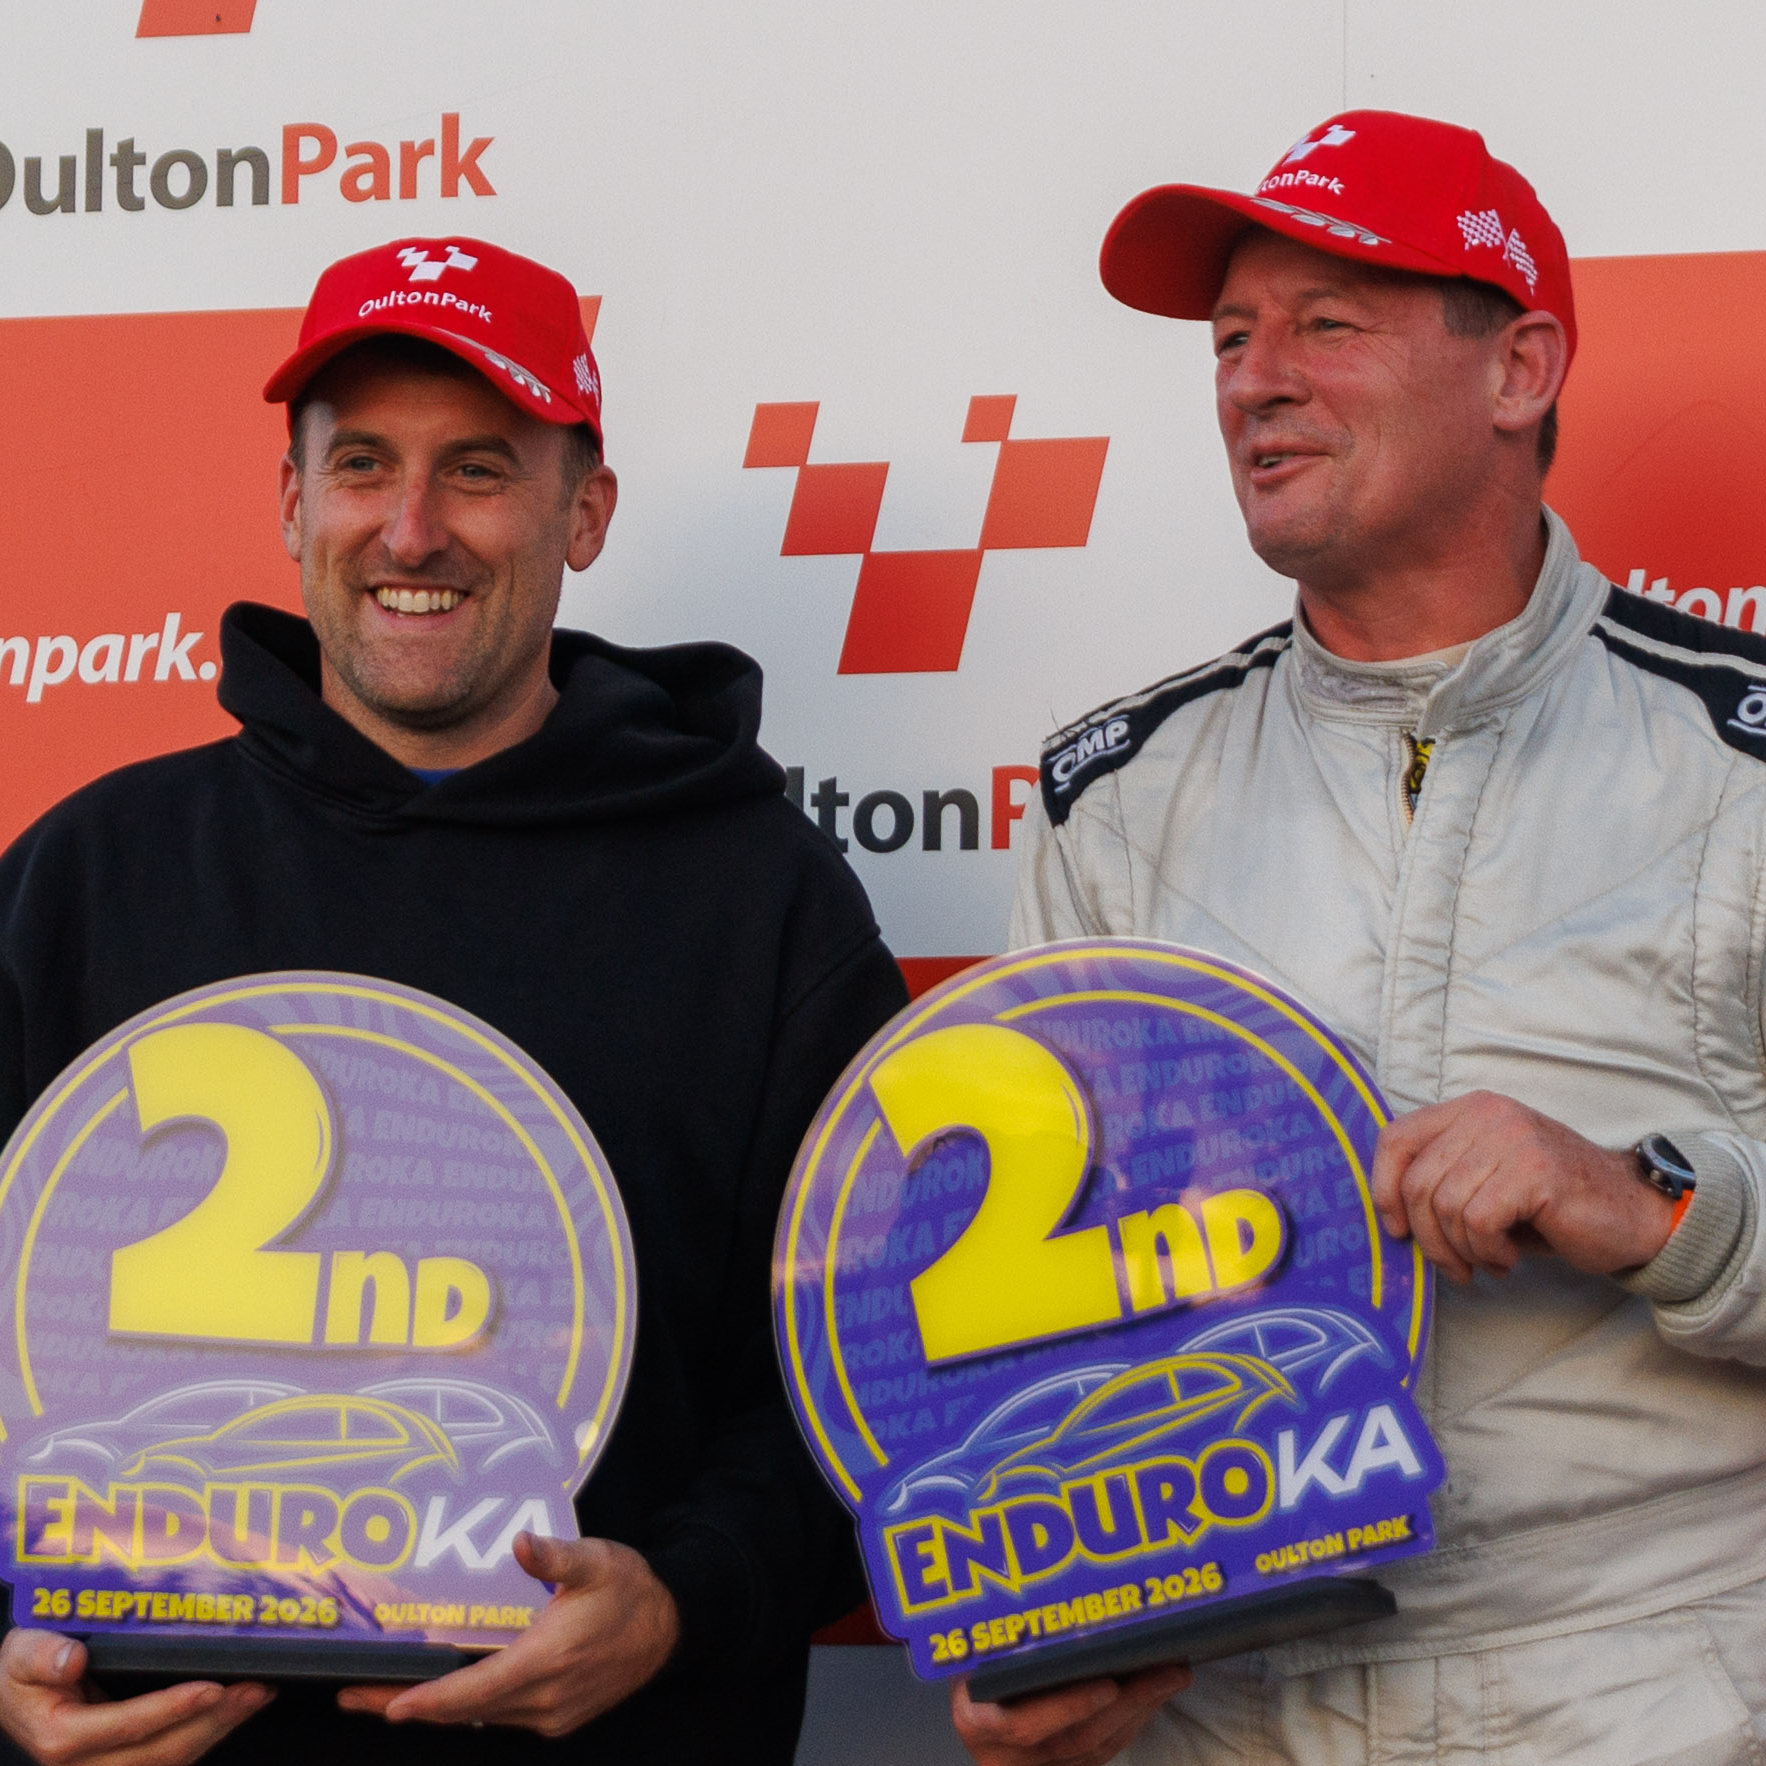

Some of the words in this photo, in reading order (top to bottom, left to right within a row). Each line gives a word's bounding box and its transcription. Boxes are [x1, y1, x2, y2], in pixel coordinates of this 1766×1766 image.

[358, 290, 493, 323] OultonPark
[1051, 715, 1129, 789] OMP
[16, 1474, 556, 1577] ENDUROKA
[883, 1403, 1422, 1616] ENDUROKA
[1254, 1531, 1346, 1574] OULTON
[1348, 1515, 1414, 1555] PARK
[33, 1587, 72, 1618] 26
[75, 1589, 255, 1623] SEPTEMBER
[260, 1594, 338, 1625] 2026
[374, 1604, 466, 1626] OULTON
[469, 1606, 532, 1628] PARK
[929, 1631, 969, 1662] 26
[972, 1585, 1145, 1651] SEPTEMBER
[1146, 1562, 1223, 1609] 2026
